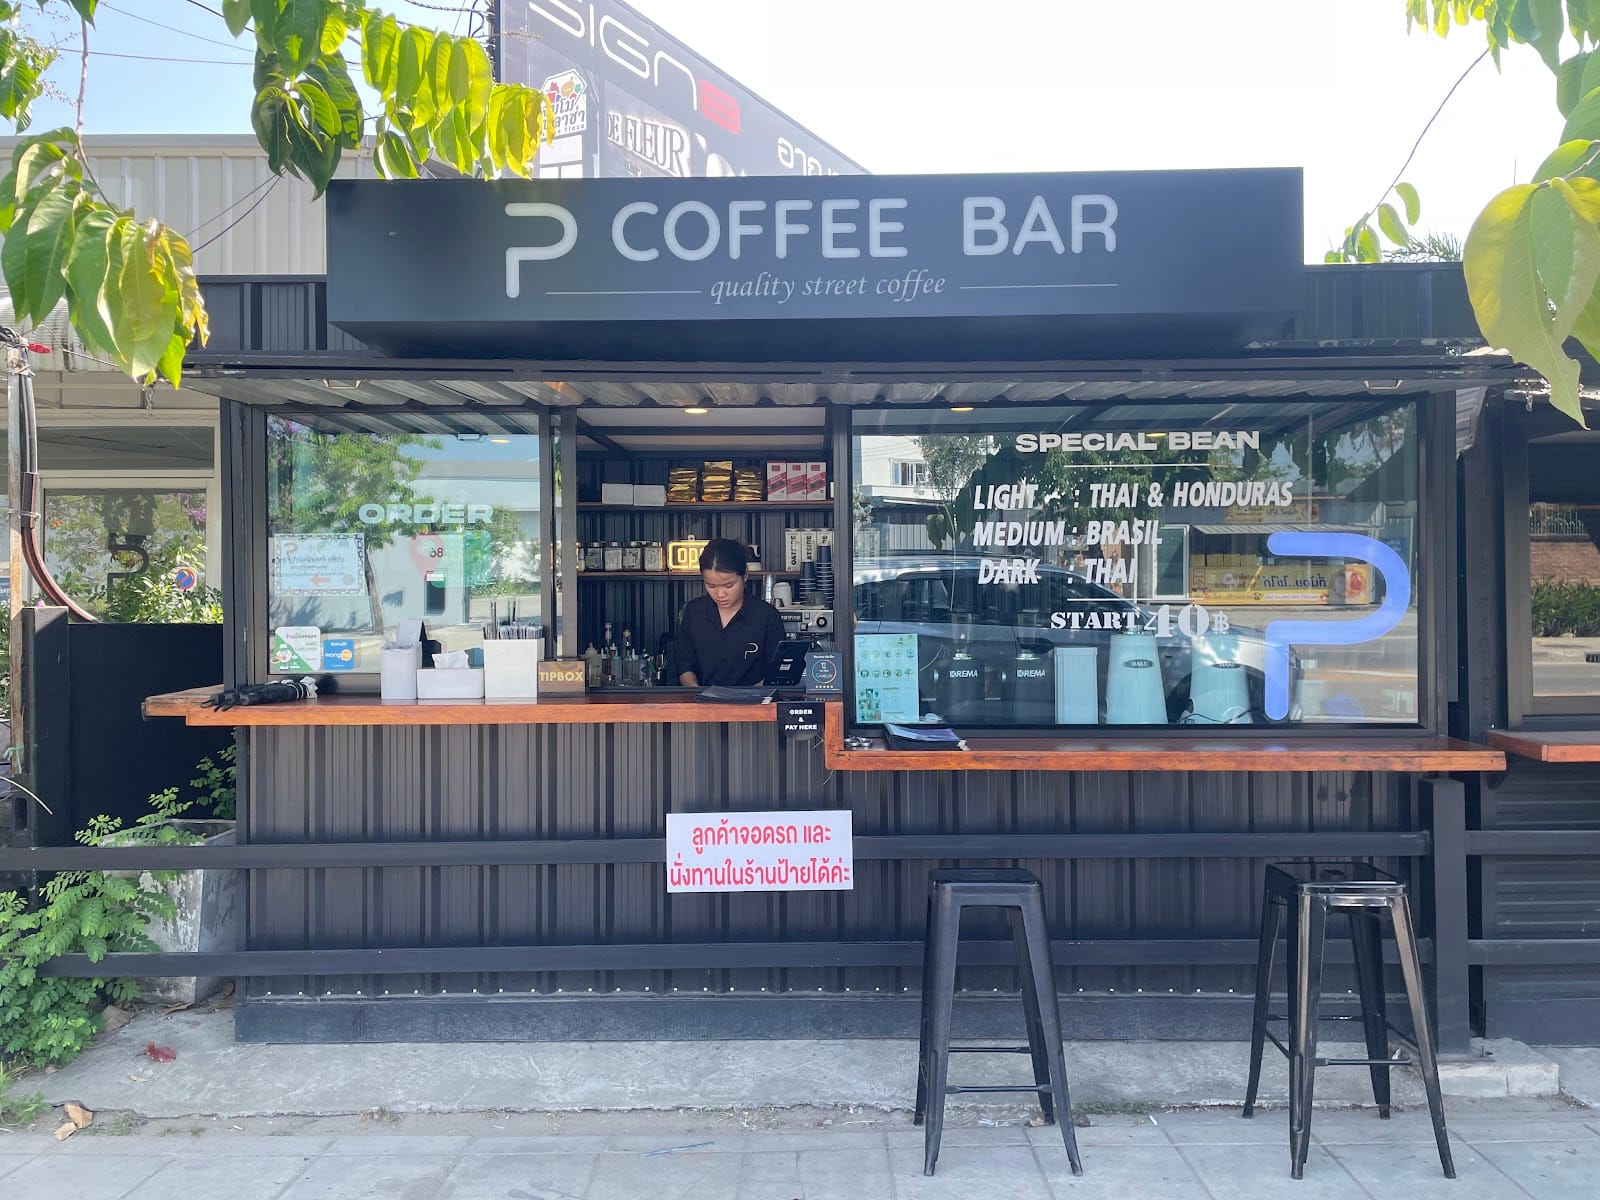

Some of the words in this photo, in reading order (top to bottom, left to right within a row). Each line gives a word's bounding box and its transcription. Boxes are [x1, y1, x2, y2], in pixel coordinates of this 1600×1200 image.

[611, 198, 909, 262] COFFEE
[963, 194, 1119, 257] BAR
[710, 271, 795, 305] quality
[802, 275, 867, 296] street
[876, 268, 945, 303] coffee
[1015, 431, 1158, 453] SPECIAL
[1168, 430, 1260, 451] BEAN
[973, 483, 1039, 510] LIGHT
[1090, 482, 1139, 508] THAI
[1147, 481, 1164, 507] &
[1173, 481, 1294, 507] HONDURAS
[358, 502, 494, 525] ORDER
[973, 520, 1066, 547] MEDIUM
[1086, 519, 1163, 546] BRASIL
[978, 558, 1041, 585] DARK
[1085, 557, 1138, 584] THAI
[1050, 610, 1141, 630] START
[538, 671, 585, 683] TIPBOX
[692, 818, 798, 855] ลูกค้าจอดรถ
[803, 824, 832, 844] และ
[670, 852, 850, 887] นั่งทานในร้านป้ายได้ค่ะ
